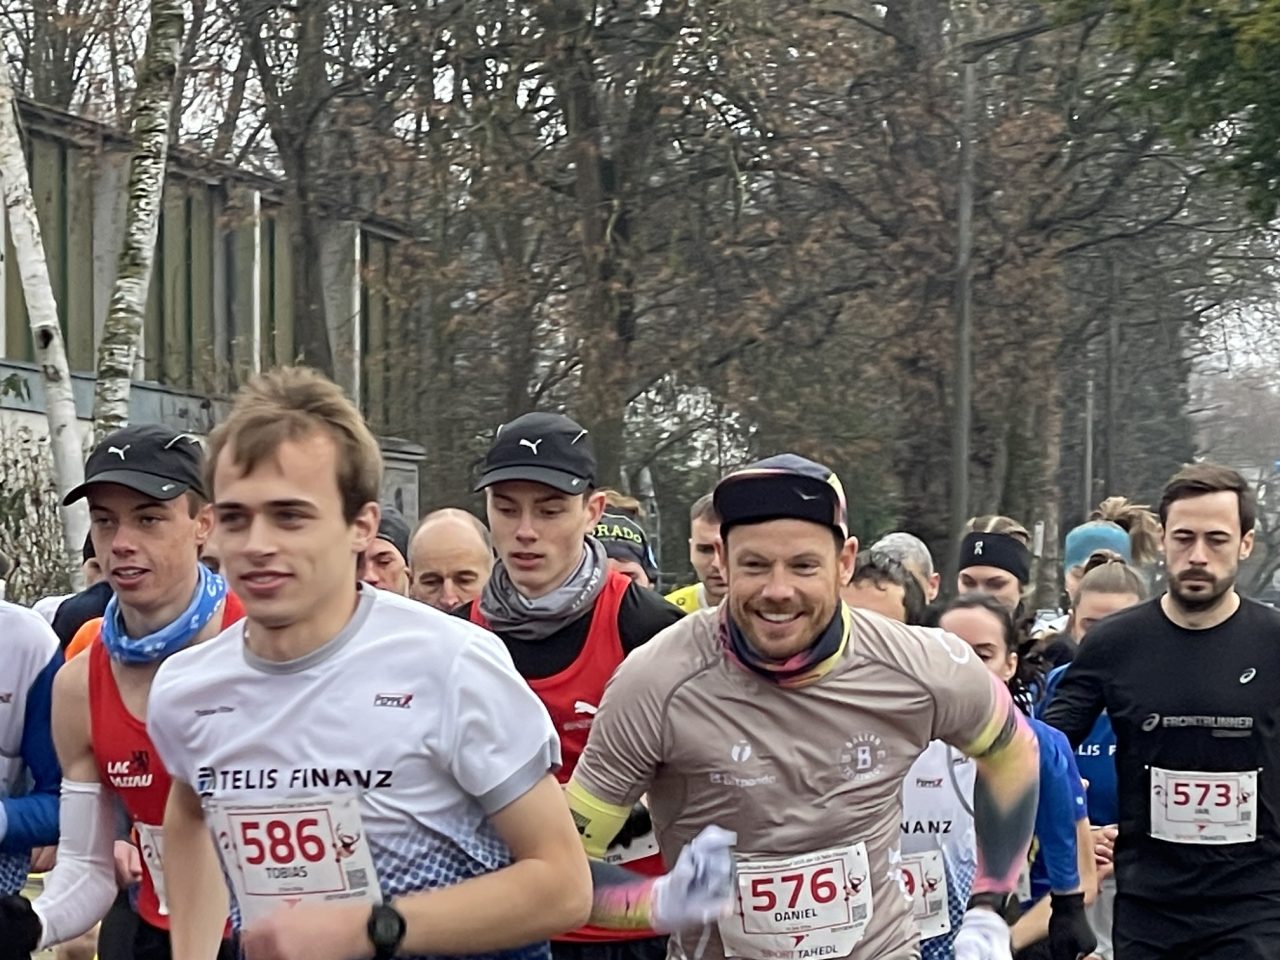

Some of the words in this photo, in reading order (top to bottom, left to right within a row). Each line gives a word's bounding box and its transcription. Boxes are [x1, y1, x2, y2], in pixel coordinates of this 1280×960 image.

[592, 524, 642, 543] RADO
[1078, 744, 1100, 756] LIS
[107, 760, 130, 774] LAC
[220, 769, 278, 789] TELIS
[289, 768, 393, 788] FINANZ
[1173, 782, 1231, 807] 573
[900, 820, 953, 834] NANZ
[240, 817, 326, 865] 586
[265, 865, 308, 878] TOBIAS
[751, 867, 837, 912] 576
[774, 908, 818, 922] DANIEL
[797, 944, 839, 959] TAHEDL
